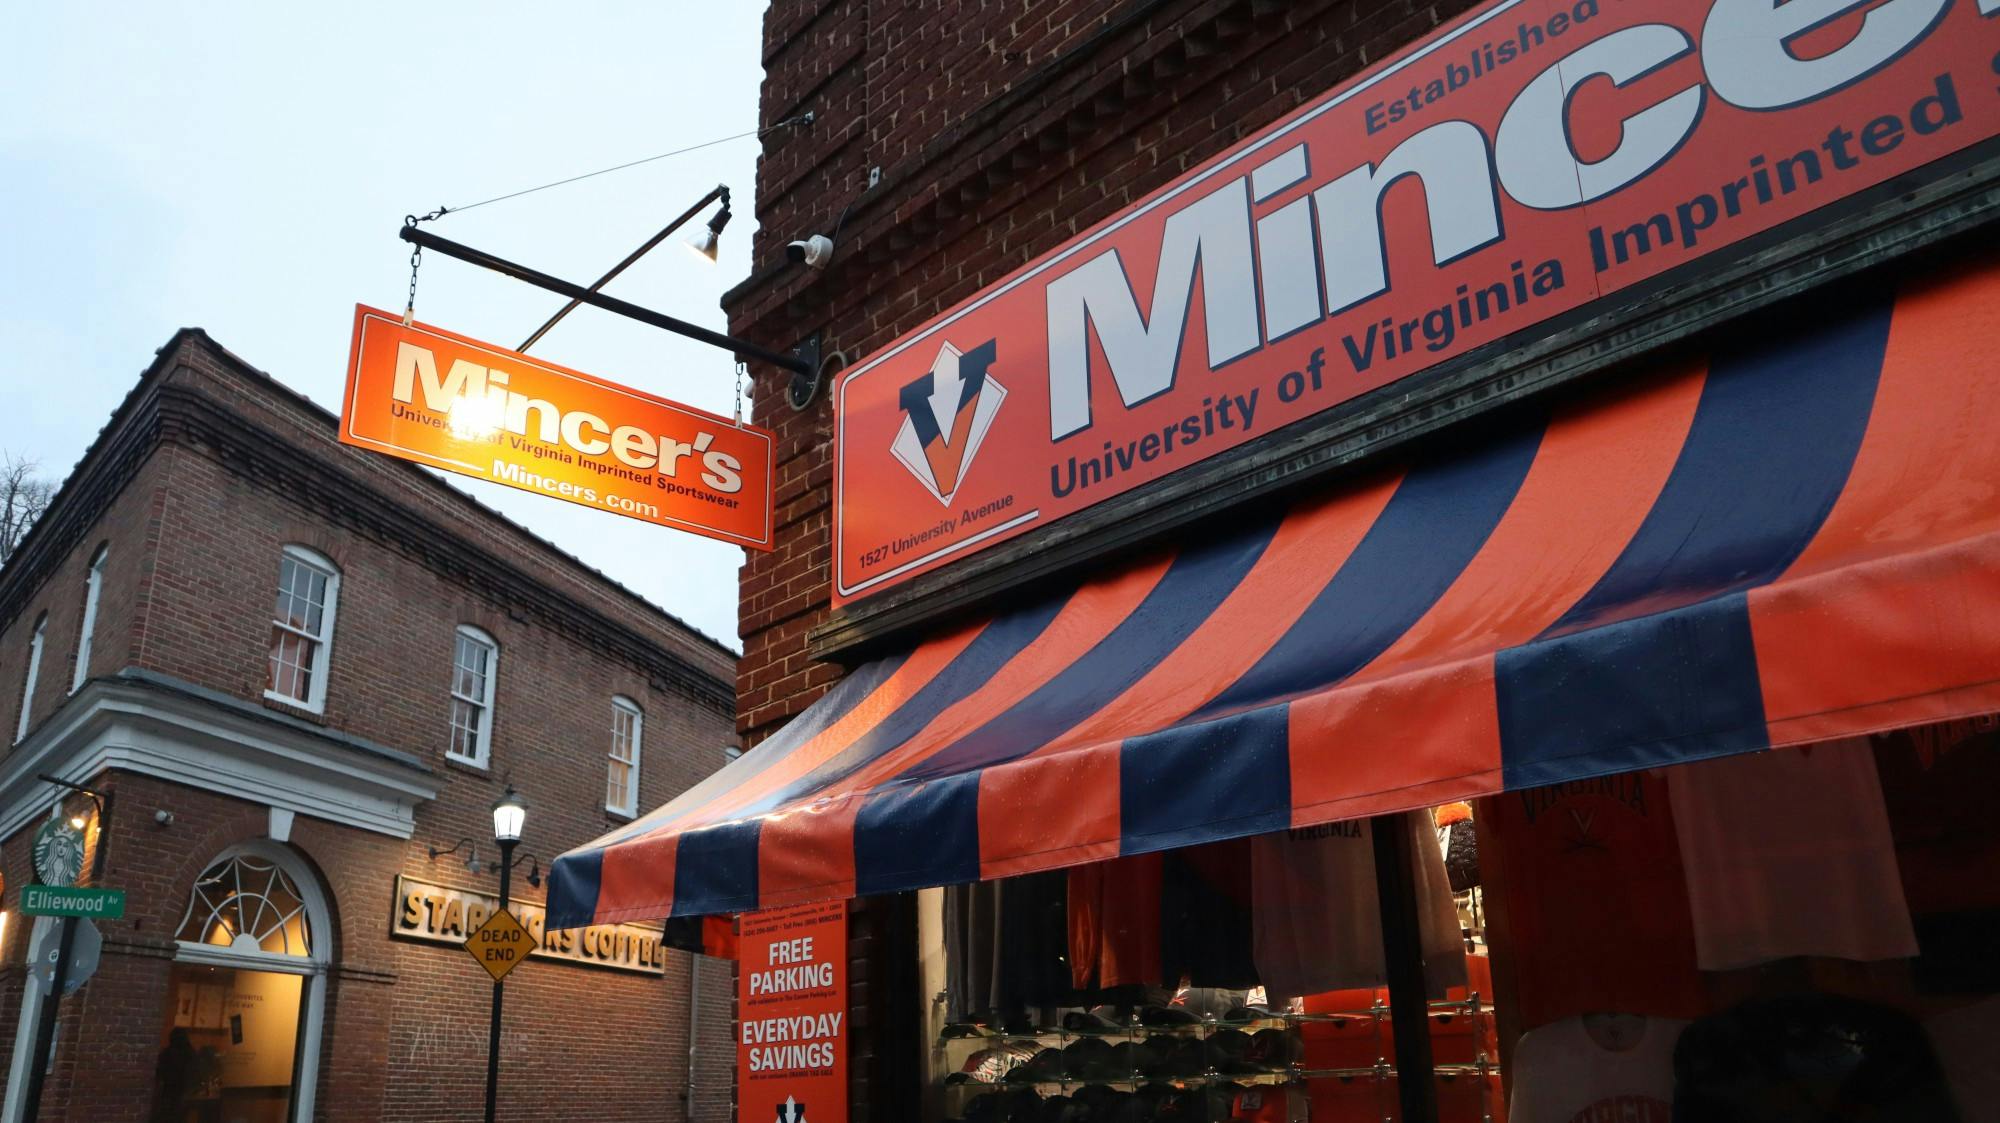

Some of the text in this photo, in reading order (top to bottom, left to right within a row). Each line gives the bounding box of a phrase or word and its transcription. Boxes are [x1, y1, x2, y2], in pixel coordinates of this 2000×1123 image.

[1045, 0, 2000, 443] Mince
[1051, 386, 1260, 499] University
[1277, 347, 1327, 403] of
[1342, 257, 1565, 373] Virginia
[1590, 72, 1964, 273] Imprinted
[391, 340, 743, 494] Mincer's
[487, 433, 505, 445] of
[510, 436, 572, 465] Virginia
[578, 455, 651, 486] Imprinted
[657, 476, 740, 510] Sportswear
[492, 459, 658, 518] Mincers.com
[859, 494, 1014, 569] 1527 University Avenue
[27, 890, 119, 912] Elliewood Av
[481, 929, 521, 942] DEAD
[485, 948, 515, 961] END
[583, 924, 662, 966] COFFEE
[769, 936, 814, 966] FREE
[750, 962, 833, 996] PARKING
[742, 1012, 842, 1045] EVERYDAY
[749, 1042, 834, 1072] SAVINGS
